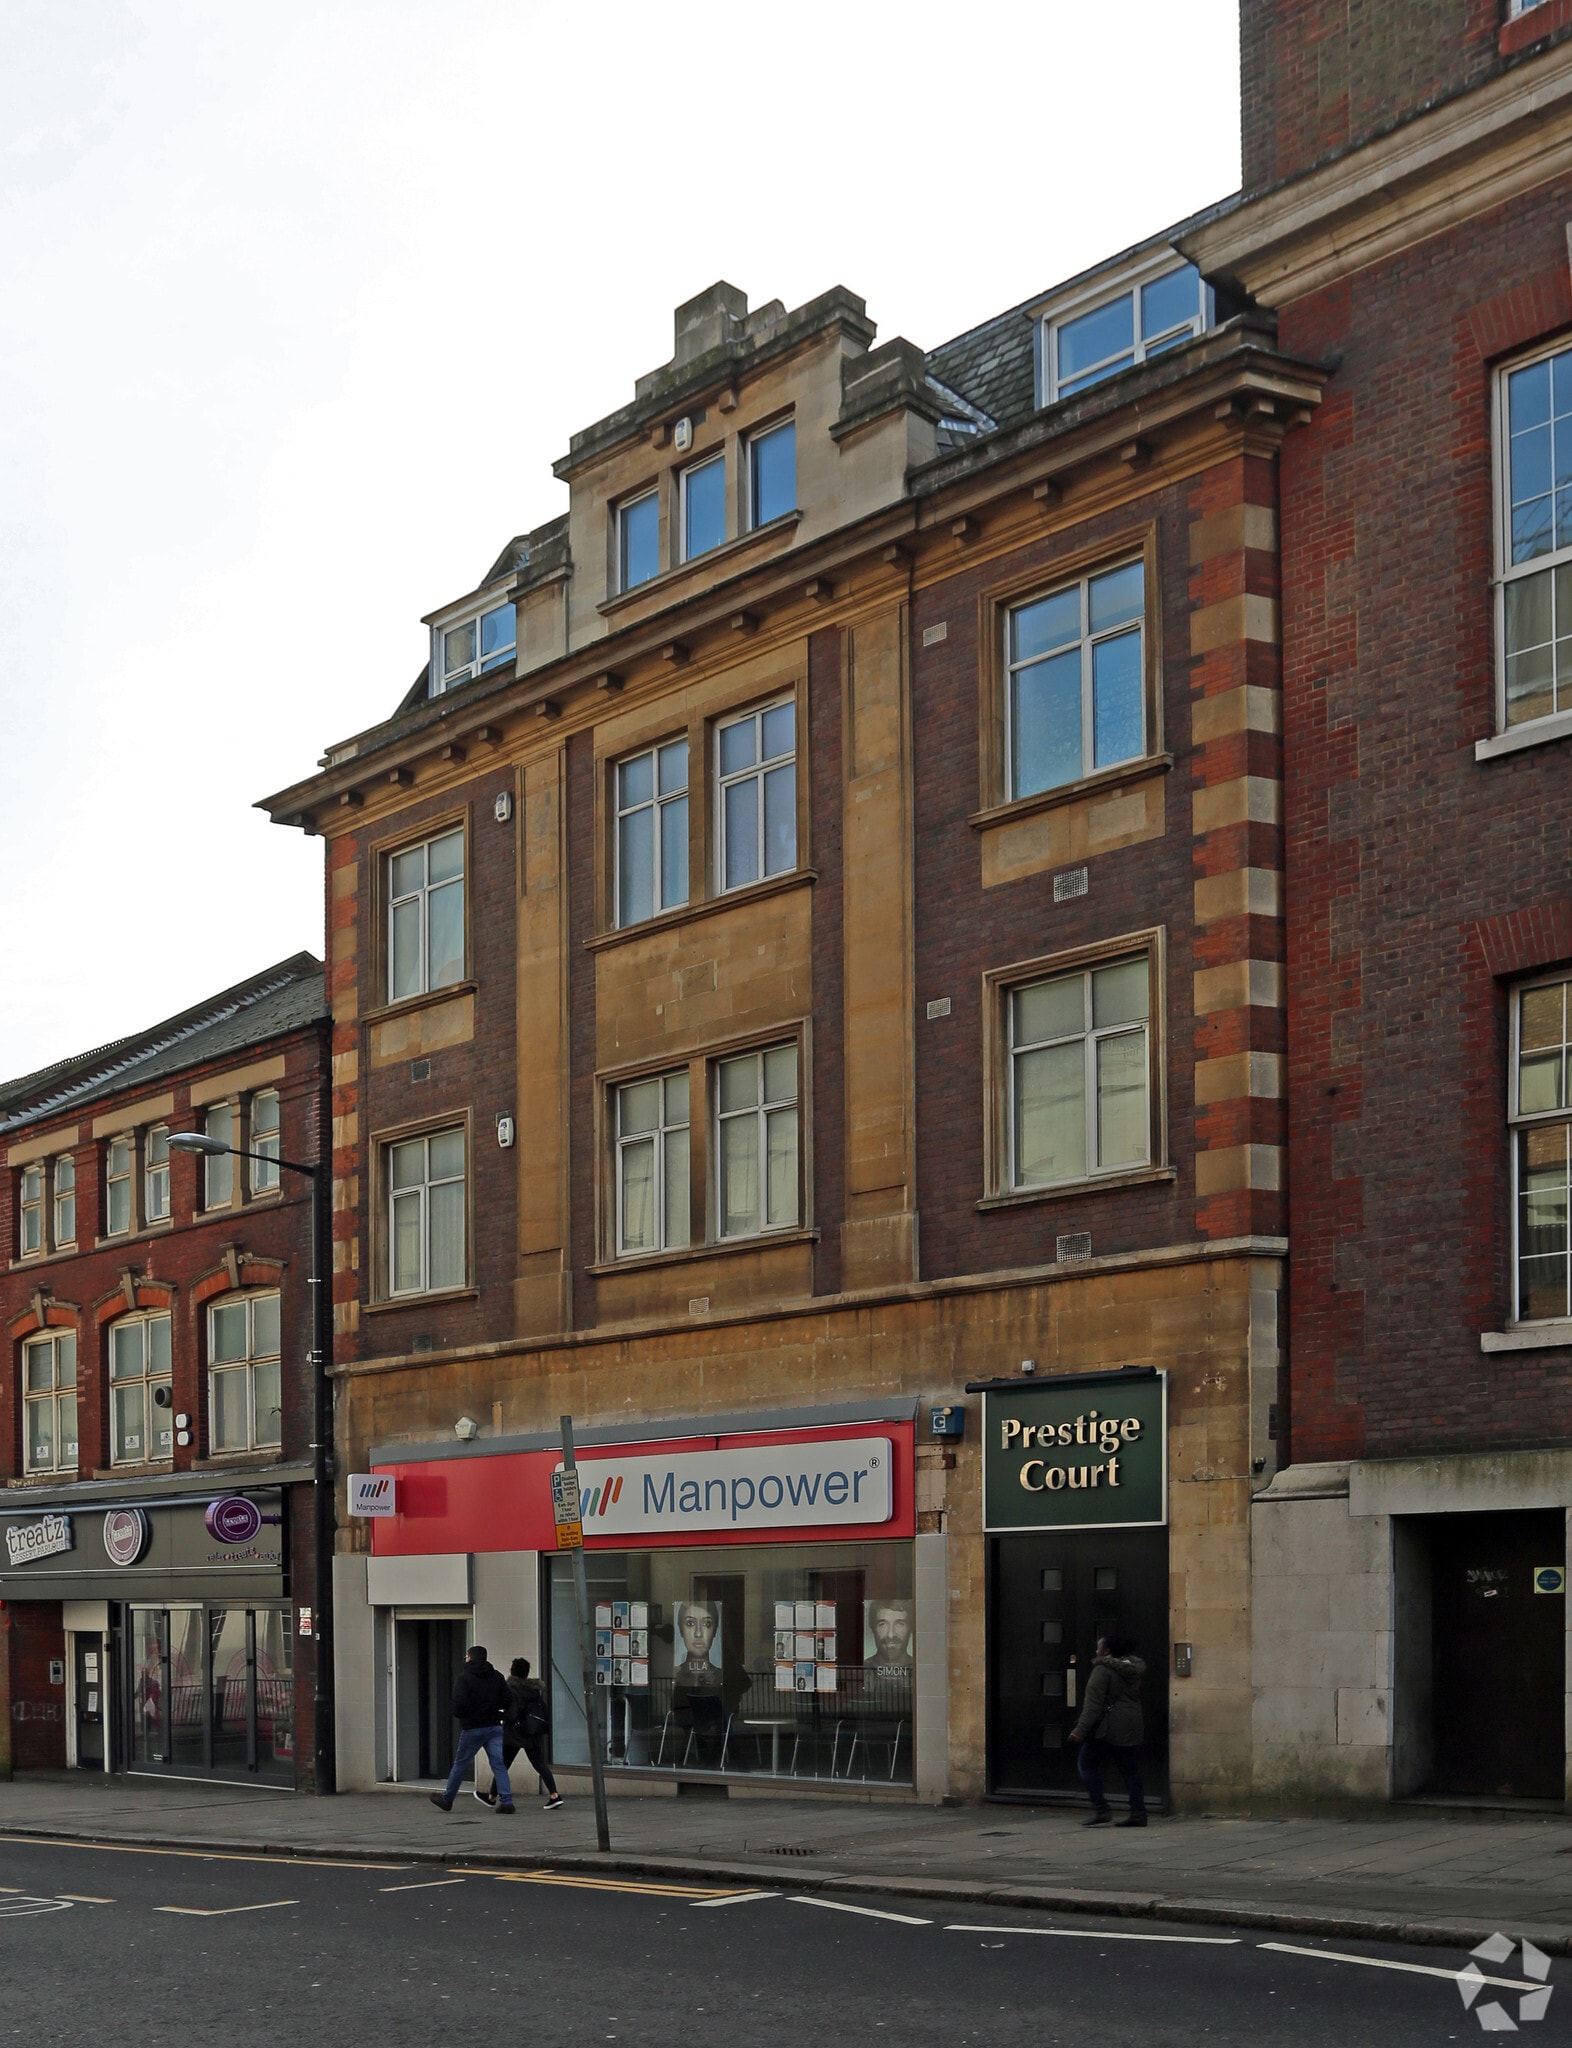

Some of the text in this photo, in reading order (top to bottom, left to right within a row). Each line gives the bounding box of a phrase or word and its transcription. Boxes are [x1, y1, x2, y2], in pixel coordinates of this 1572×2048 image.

[1001, 1410, 1140, 1453] Prestige
[1019, 1457, 1120, 1492] Court
[553, 1475, 560, 1487] P
[356, 1503, 391, 1512] Manpower
[8, 1519, 64, 1553] treatz
[688, 1661, 708, 1671] LILA
[877, 1665, 907, 1676] SIMON
